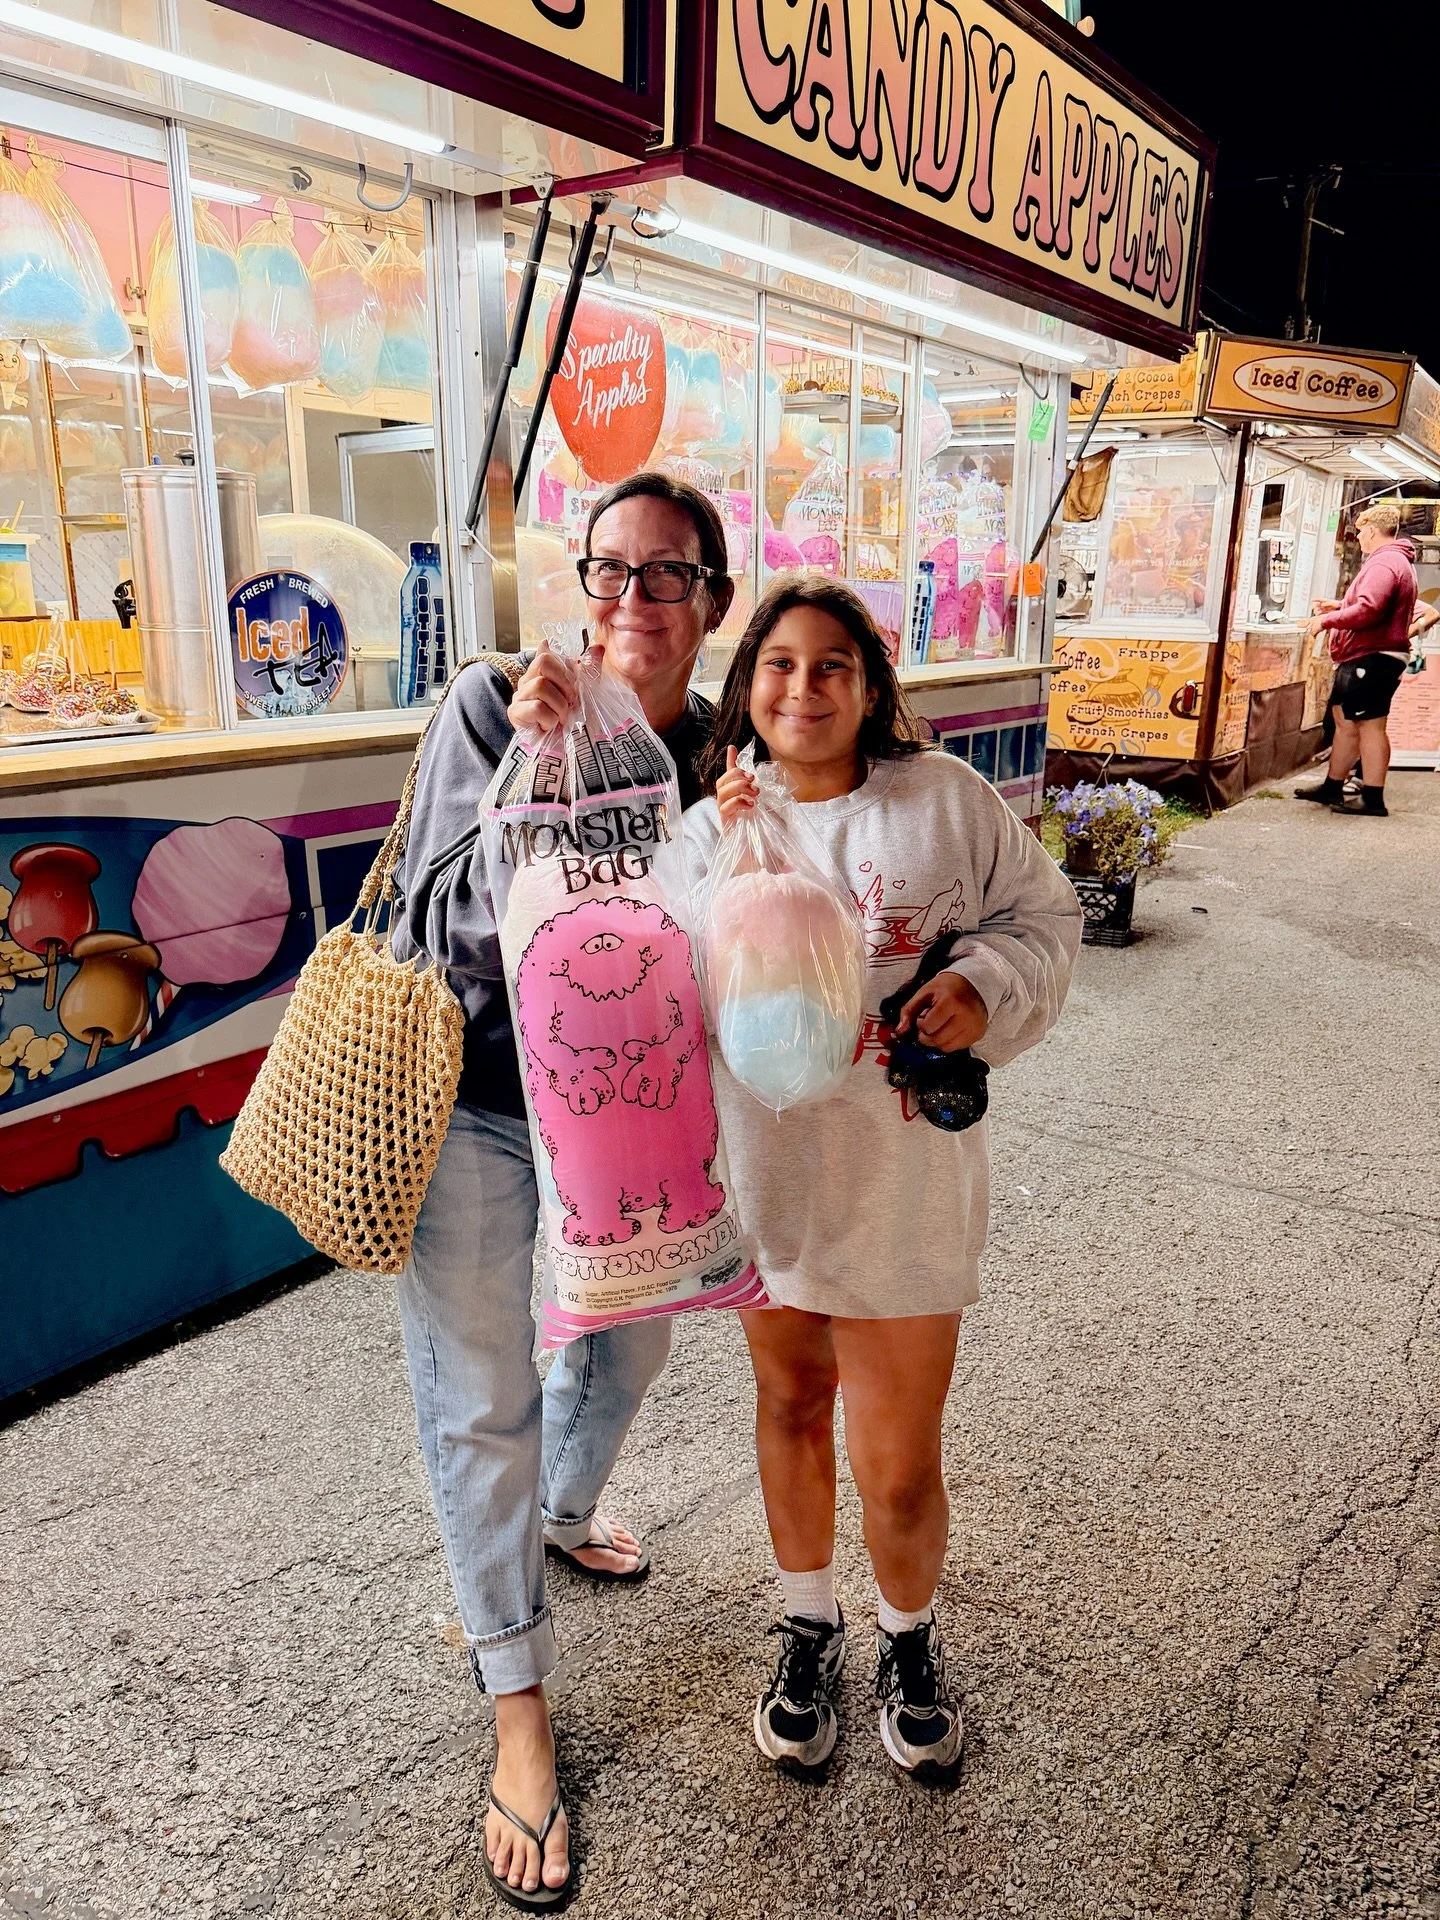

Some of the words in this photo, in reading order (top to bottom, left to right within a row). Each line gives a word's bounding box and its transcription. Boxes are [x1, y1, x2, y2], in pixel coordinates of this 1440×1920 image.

[733, 0, 1015, 222] CANDY
[1013, 70, 1189, 309] APPLES
[557, 325, 654, 391] Specialty
[1097, 373, 1119, 385] Ta
[1137, 371, 1175, 384] Cocoa
[1250, 366, 1298, 392] Iced
[1306, 373, 1383, 401] Coffee
[572, 367, 653, 429] Apples
[1085, 390, 1130, 403] Frnch
[1135, 389, 1181, 404] Crepes
[239, 578, 275, 605] FRESH
[288, 577, 329, 609] BREWED
[236, 606, 311, 662] Iced
[414, 575, 431, 700] BOTTLED
[1059, 651, 1100, 669] Coffee
[1118, 647, 1179, 662] Frappe
[243, 689, 273, 713] SWEET
[295, 685, 332, 715] UNSWEET
[1050, 680, 1087, 692] offee
[1070, 705, 1103, 716] Fruit
[1106, 706, 1169, 720] Smoothies
[1069, 725, 1116, 737] French
[1121, 728, 1169, 743] Crepes
[655, 1209, 738, 1269] CANDY
